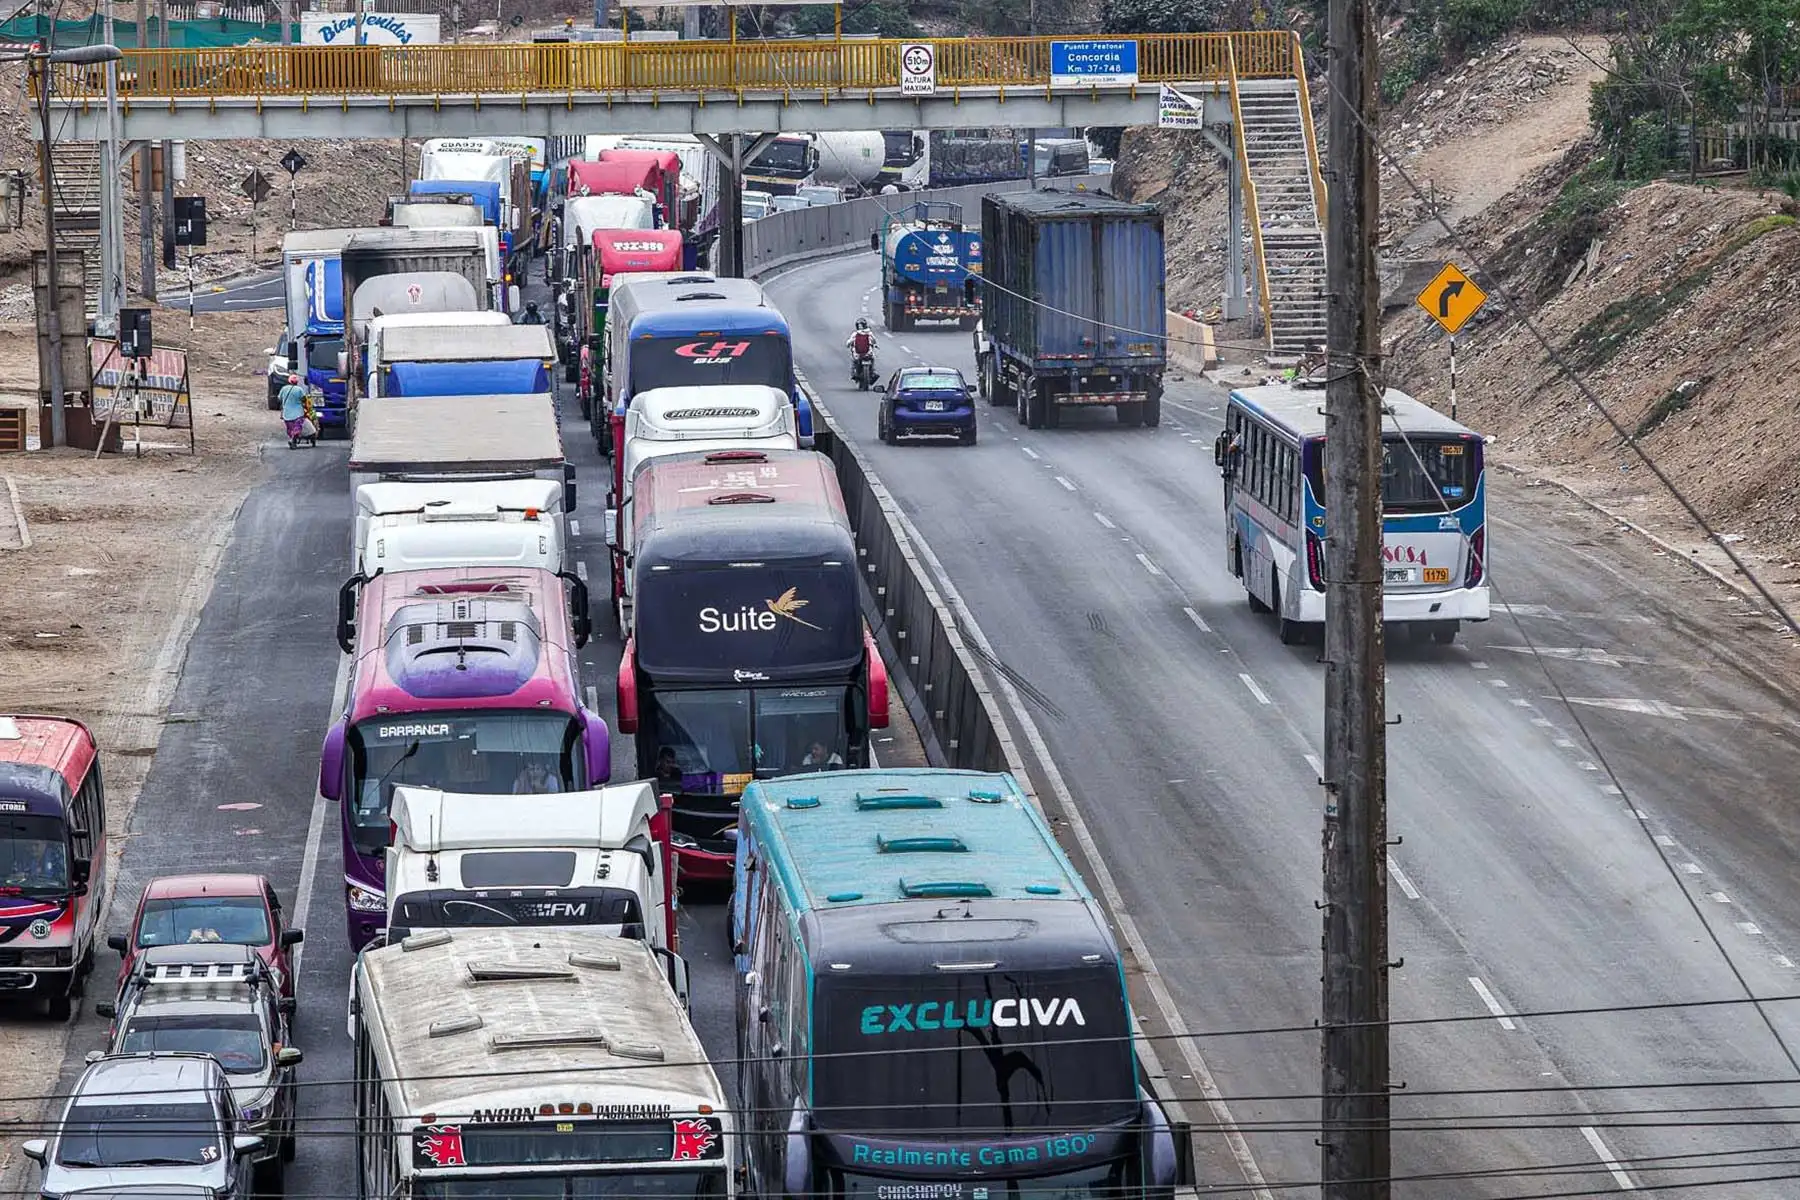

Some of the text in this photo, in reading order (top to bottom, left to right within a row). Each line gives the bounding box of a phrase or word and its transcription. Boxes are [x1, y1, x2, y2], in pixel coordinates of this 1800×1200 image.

[1064, 43, 1089, 51] Puente
[1068, 52, 1120, 62] Concordia
[1067, 64, 1082, 73] Km
[904, 76, 932, 84] ALTURA
[671, 408, 752, 418] FREIGHTLINER
[1425, 570, 1446, 580] 1179
[699, 606, 776, 632] Suite
[380, 724, 449, 737] BARRANCA
[550, 903, 587, 916] FM
[34, 925, 46, 935] SB
[860, 998, 1086, 1035] EXCLUCIVA
[853, 1144, 971, 1166] Realmente
[979, 1145, 1039, 1166] Cama
